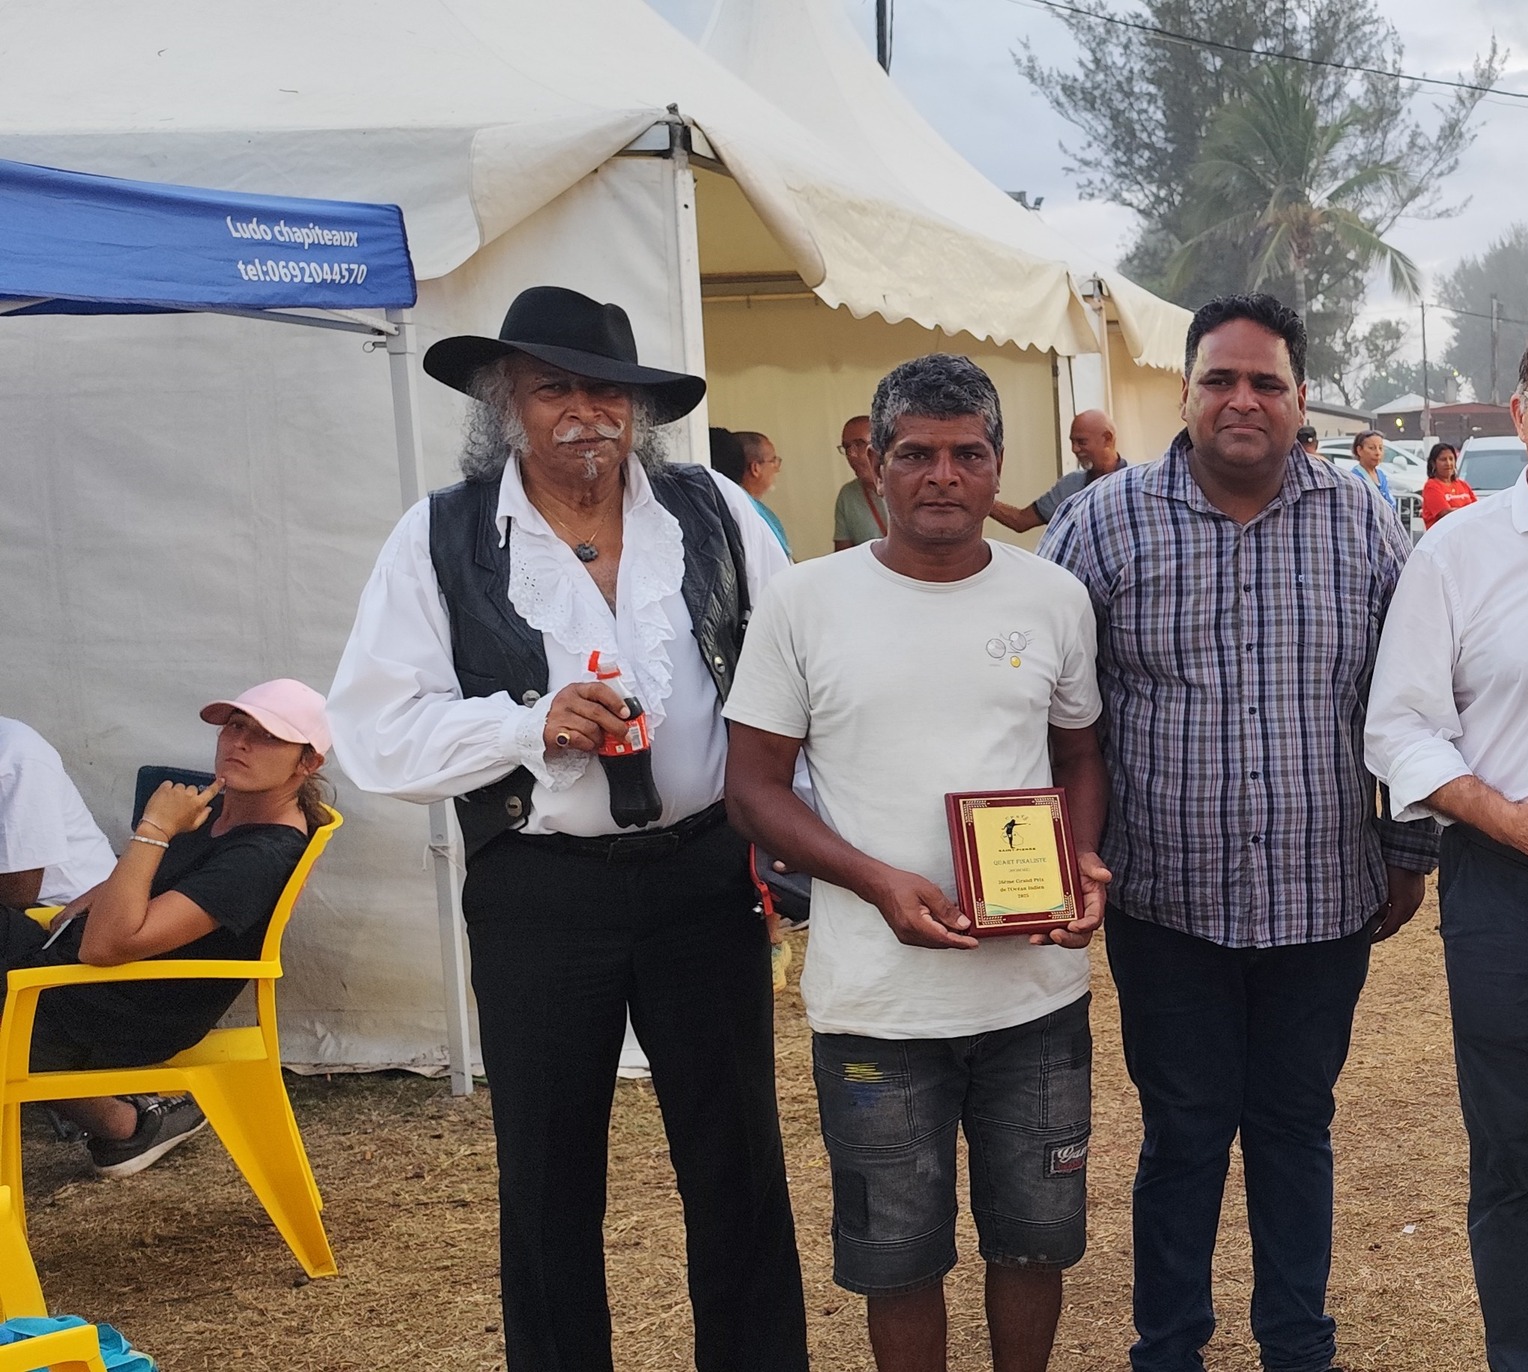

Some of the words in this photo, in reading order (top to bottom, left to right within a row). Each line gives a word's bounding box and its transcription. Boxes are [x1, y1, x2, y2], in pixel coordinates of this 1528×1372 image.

[226, 215, 272, 241] Ludo
[273, 219, 358, 250] chapiteaux
[237, 258, 367, 285] tel:0692044570
[1016, 857, 1047, 865] FINALISTE
